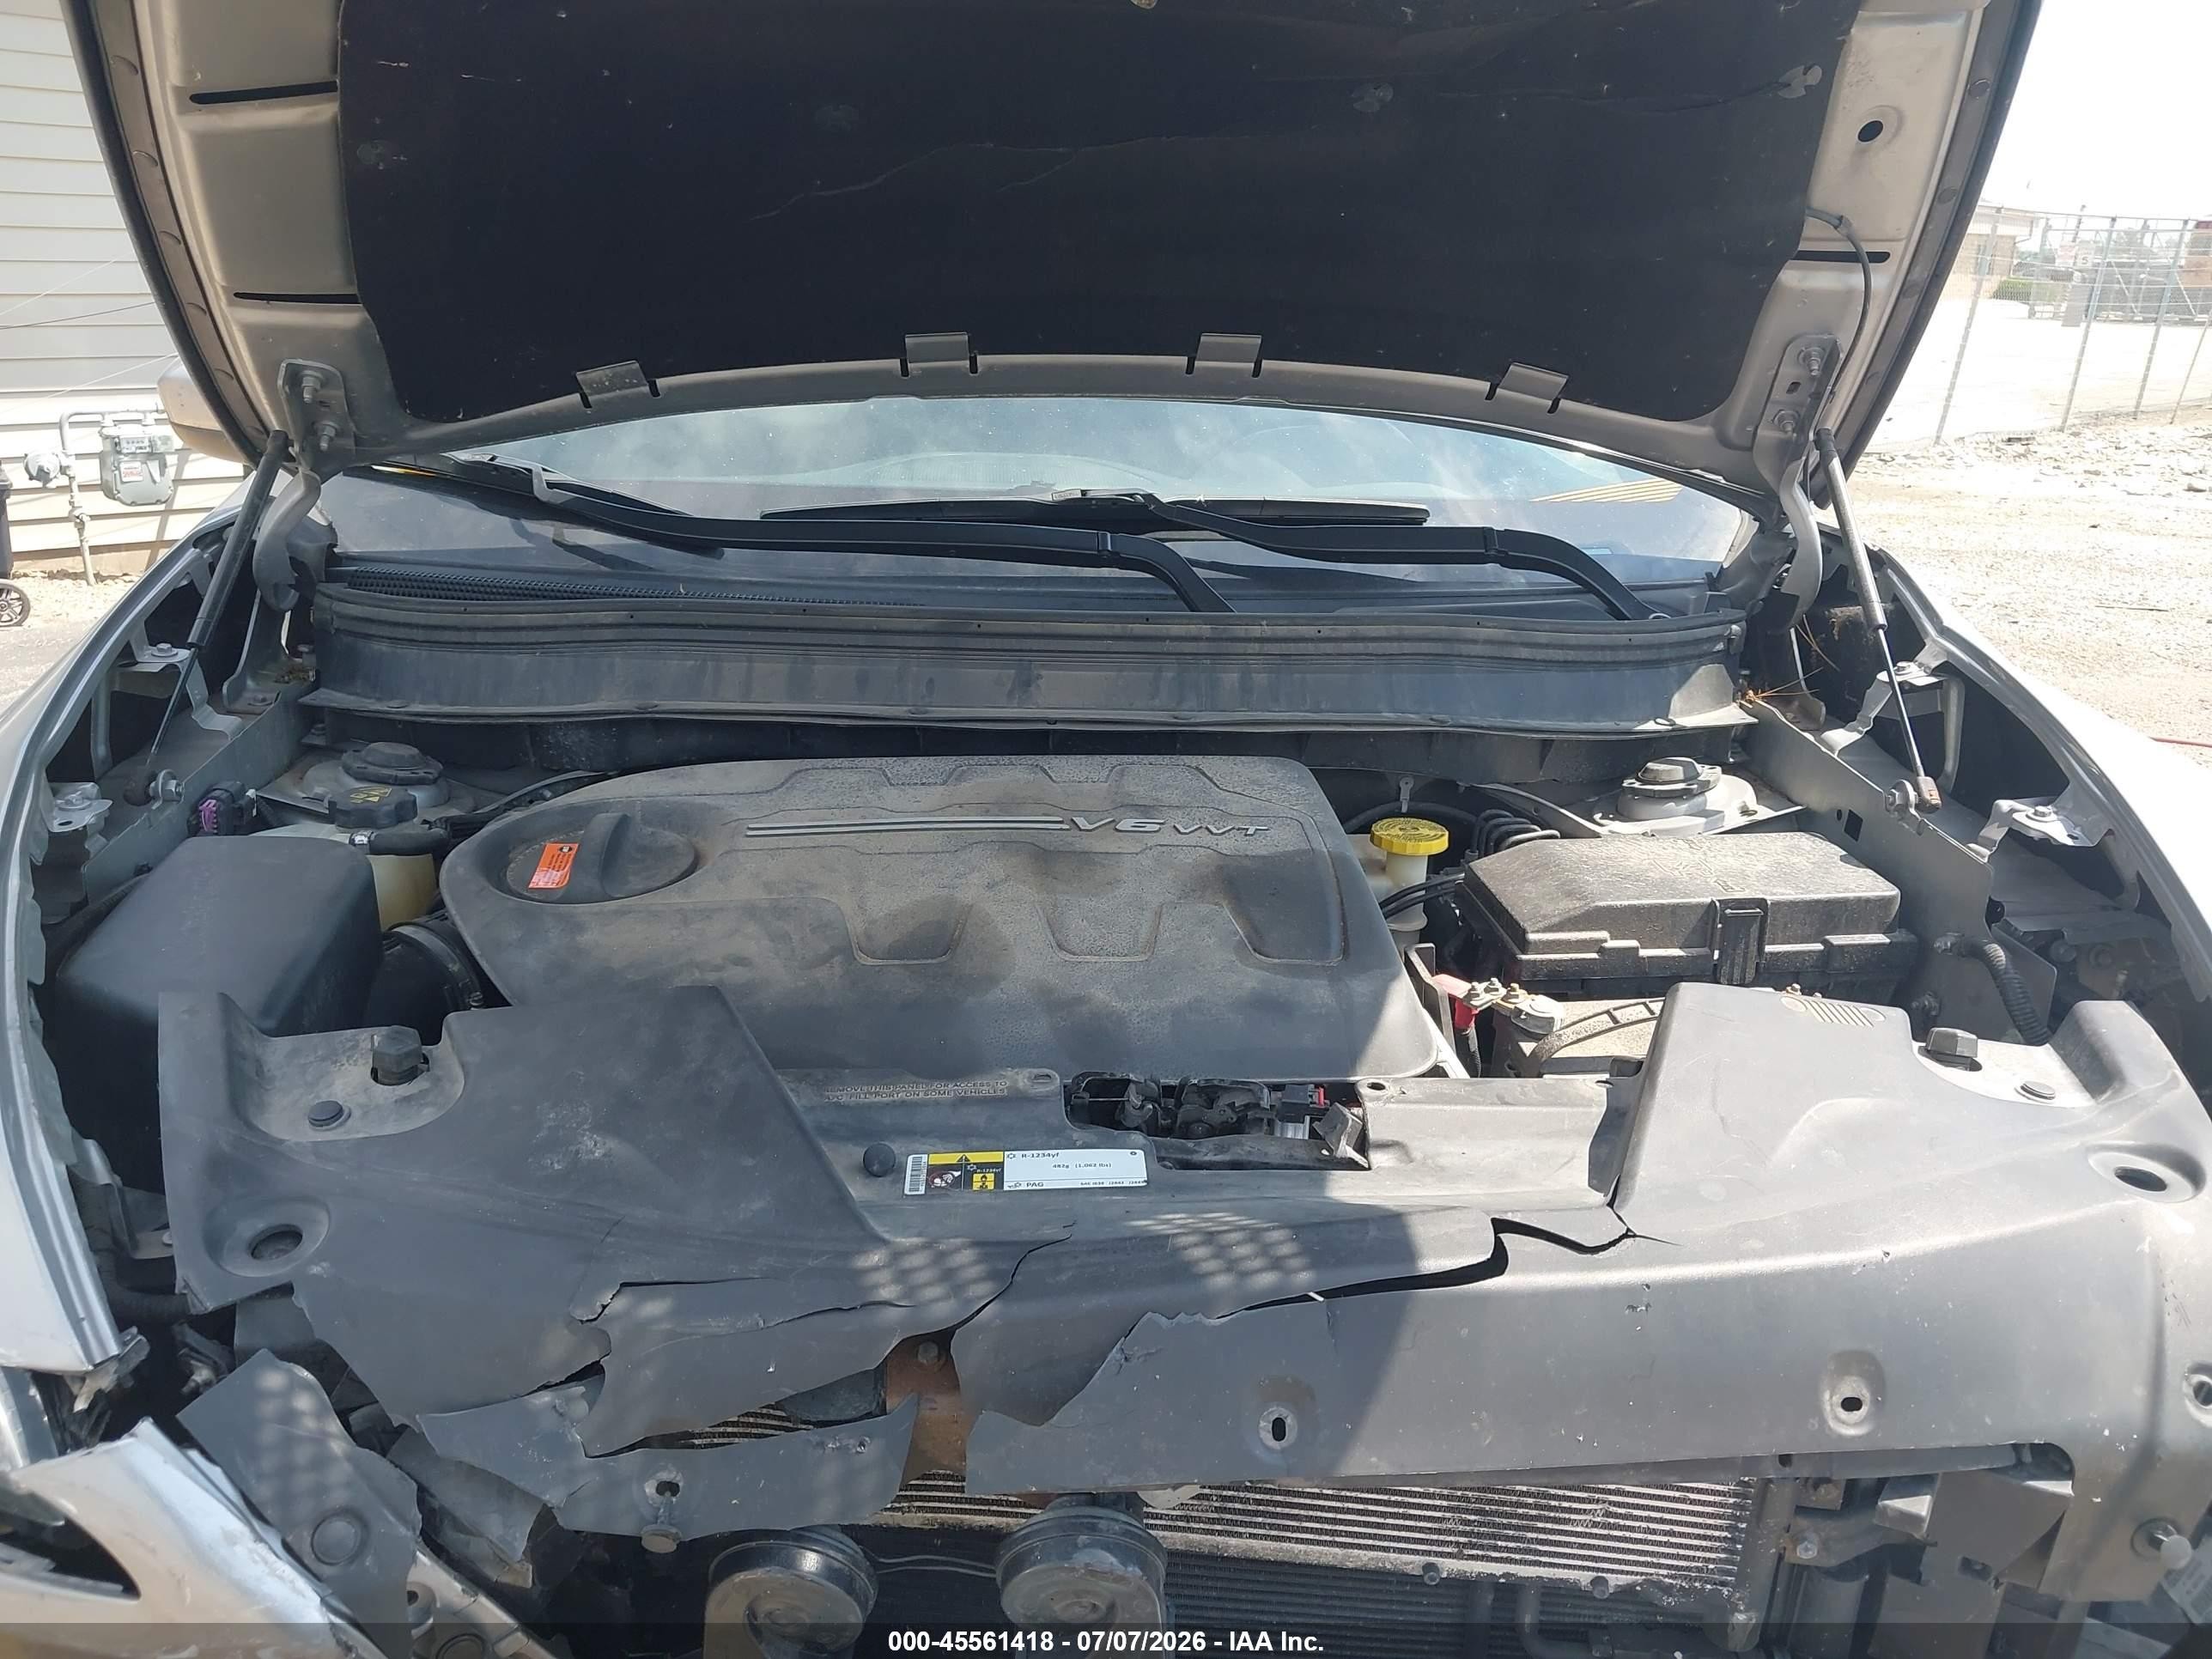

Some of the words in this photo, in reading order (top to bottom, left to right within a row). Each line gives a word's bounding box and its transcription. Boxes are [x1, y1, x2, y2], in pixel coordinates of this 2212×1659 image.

[1071, 816, 1166, 833] V6
[1174, 823, 1271, 836] VVT
[895, 1083, 928, 1091] PANEL
[957, 1088, 1006, 1097] VEHICLES
[1021, 1152, 1060, 1161] R-1234yf
